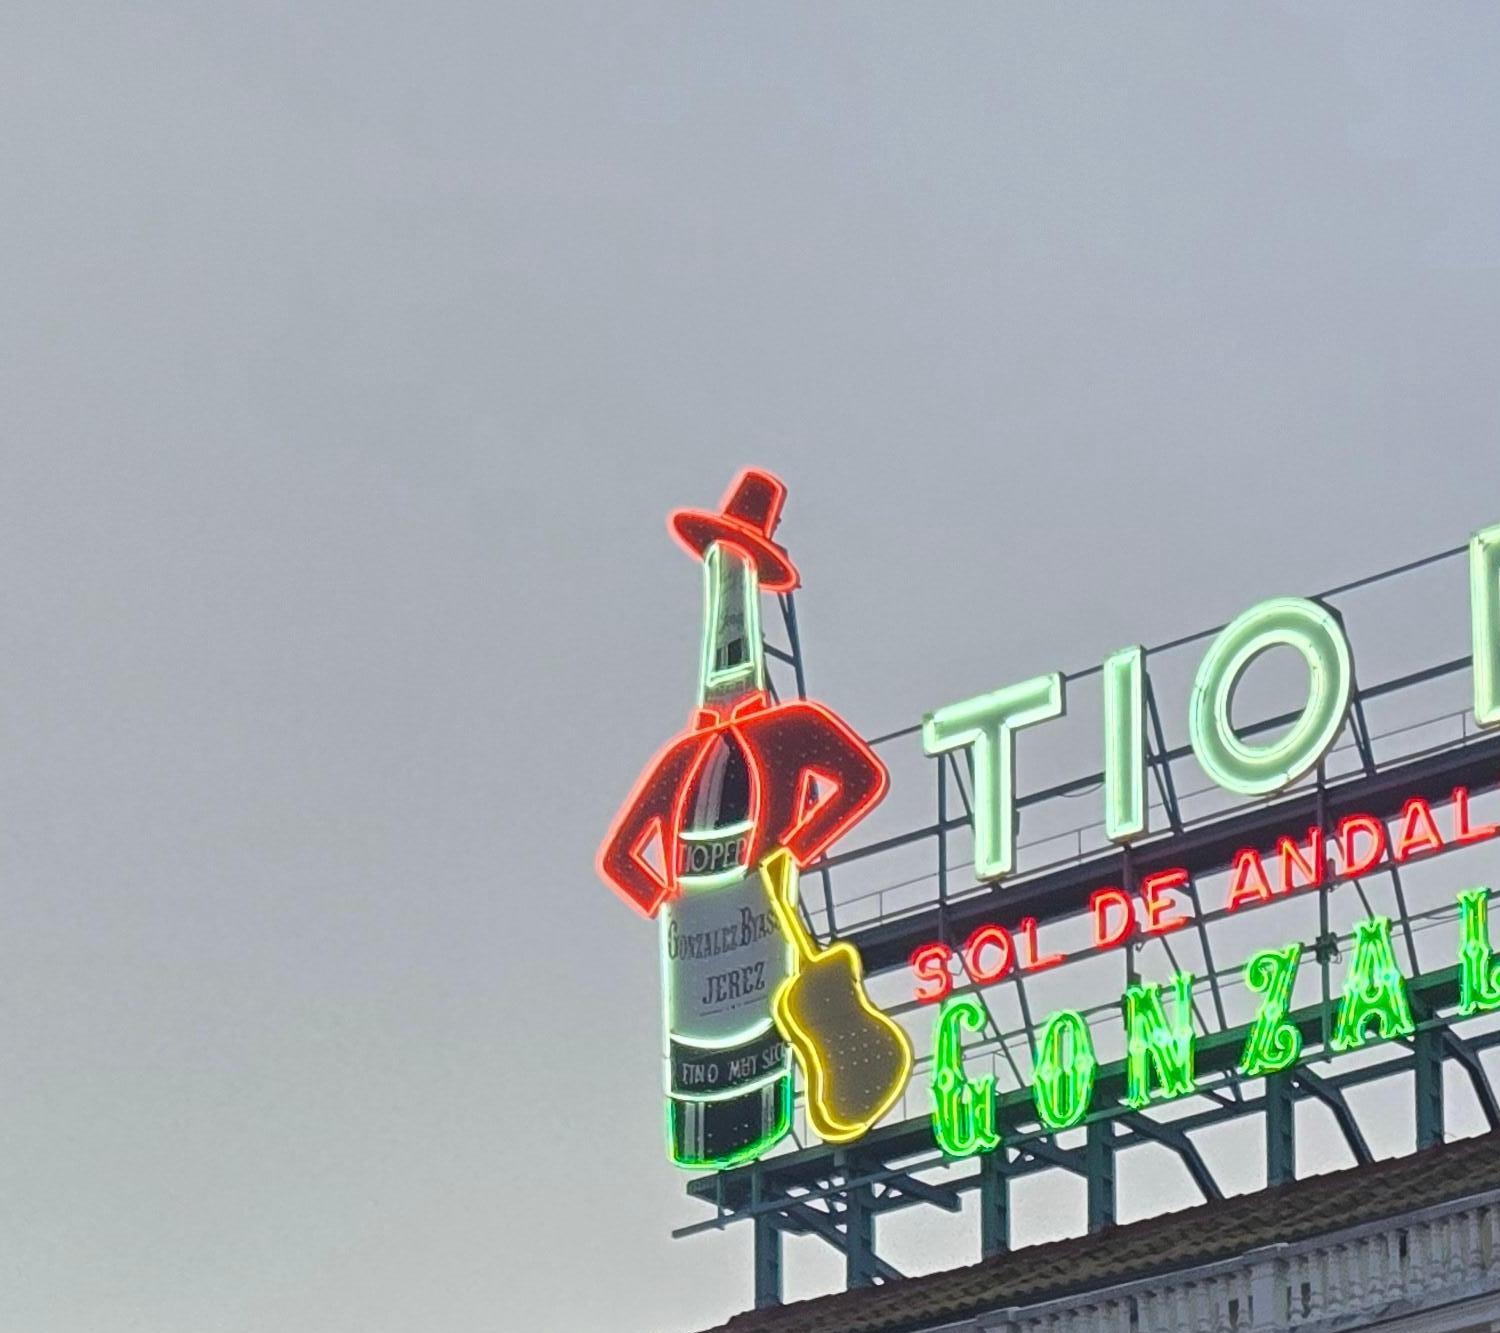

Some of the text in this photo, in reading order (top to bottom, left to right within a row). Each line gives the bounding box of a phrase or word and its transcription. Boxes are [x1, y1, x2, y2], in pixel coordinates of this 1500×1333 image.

[923, 596, 1354, 882] TIO
[668, 920, 737, 960] GONZALEZ
[911, 916, 1067, 1004] SOL
[1090, 868, 1190, 953] DE
[702, 961, 765, 1004] JEREZ
[682, 1063, 719, 1085] FINO
[728, 1055, 758, 1082] MUY
